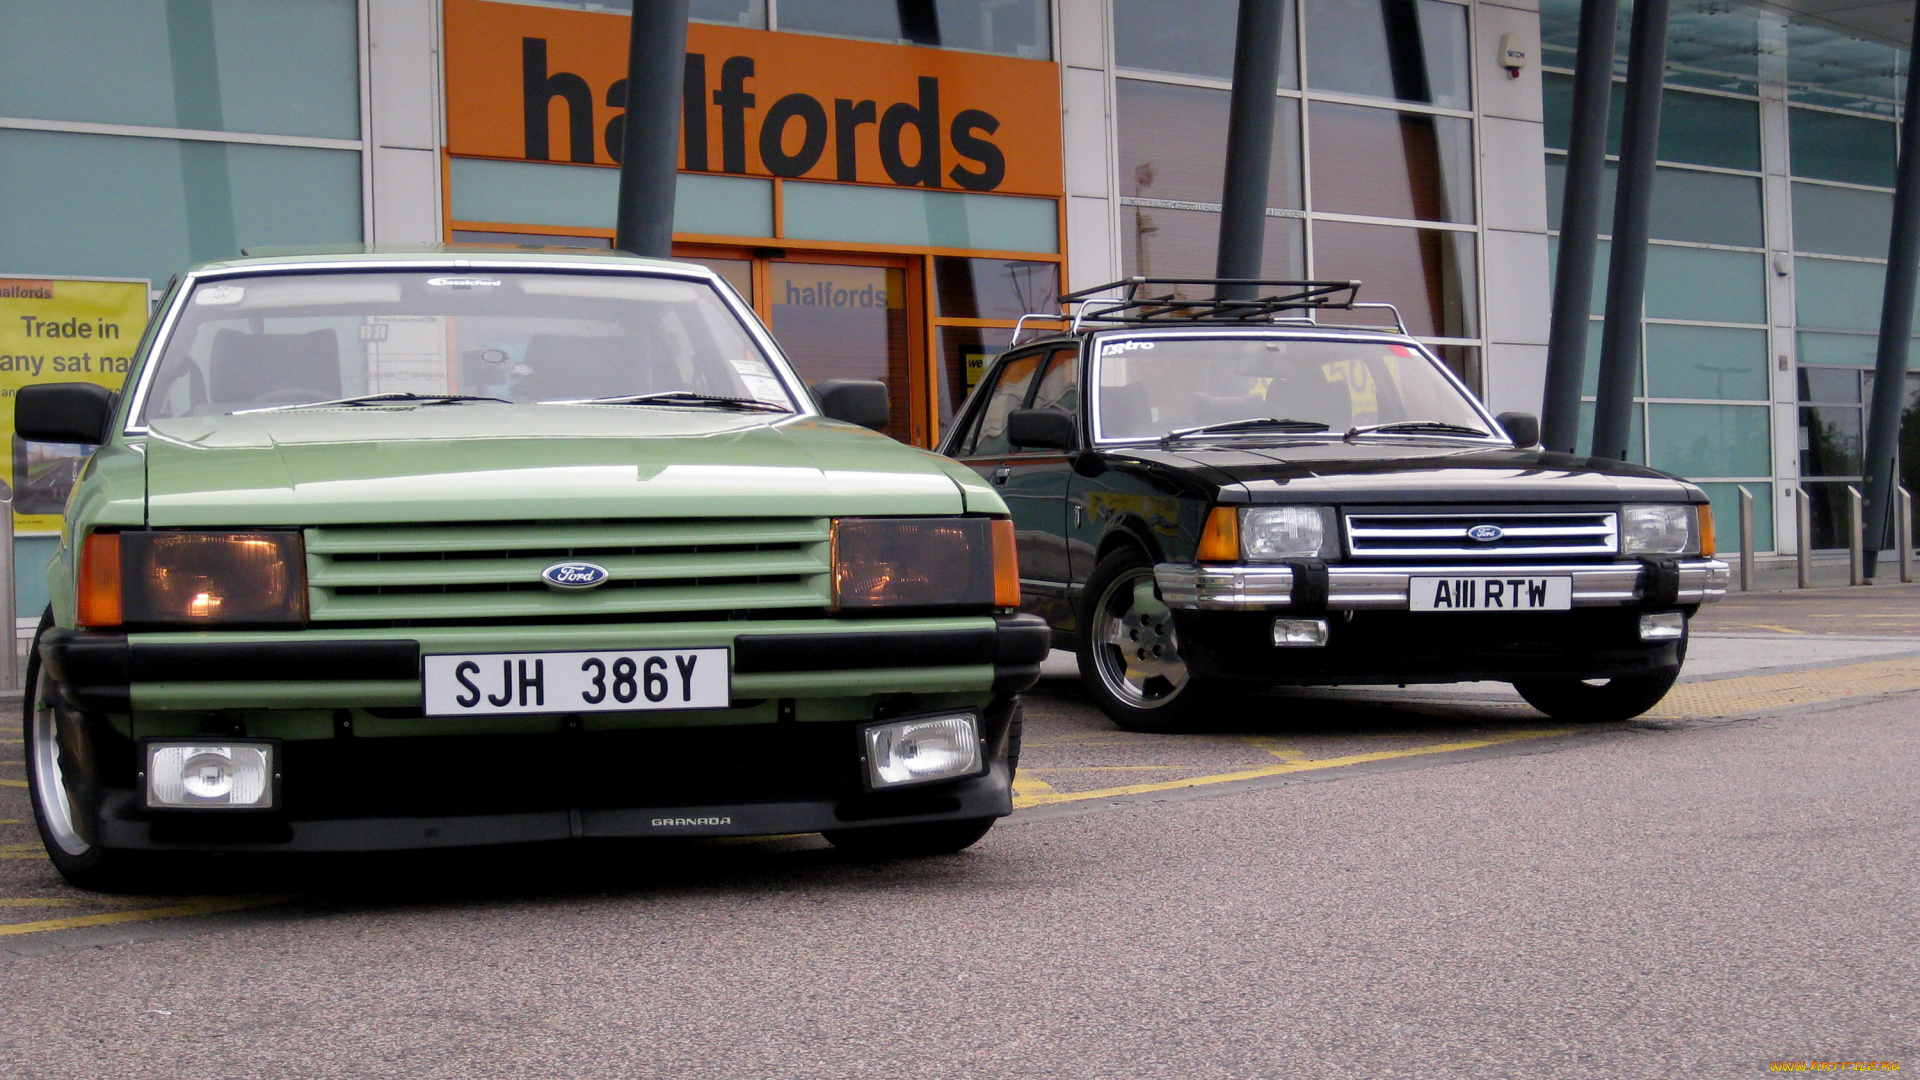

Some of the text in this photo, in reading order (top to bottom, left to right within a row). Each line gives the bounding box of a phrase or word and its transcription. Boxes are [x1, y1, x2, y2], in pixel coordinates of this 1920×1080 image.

[785, 279, 889, 308] halfords
[21, 315, 119, 339] Trade in
[1103, 340, 1155, 352] retro
[0, 352, 133, 377] any sat na
[1476, 527, 1496, 537] Ford
[557, 566, 594, 582] Ford
[1484, 580, 1547, 608] RTW
[455, 655, 697, 708] SJH 386Y
[651, 817, 731, 827] GRANADA
